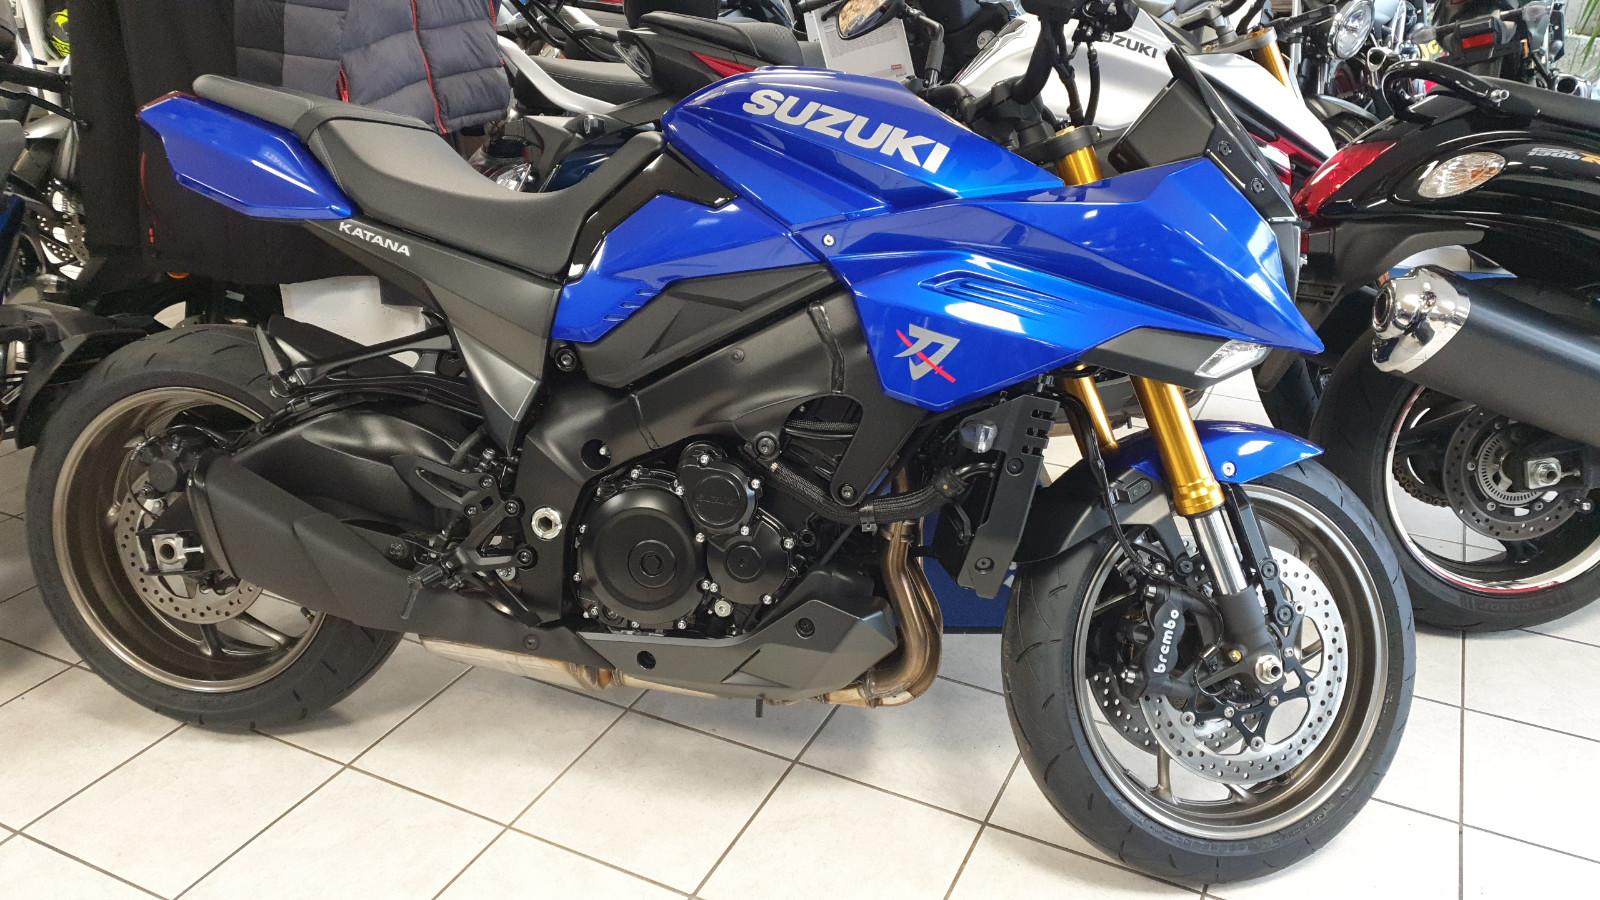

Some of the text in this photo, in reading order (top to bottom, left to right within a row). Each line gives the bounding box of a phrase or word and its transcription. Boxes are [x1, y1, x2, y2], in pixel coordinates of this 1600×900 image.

[742, 89, 950, 174] SUZUKI
[338, 221, 410, 257] KATANA
[1153, 609, 1180, 673] brembo
